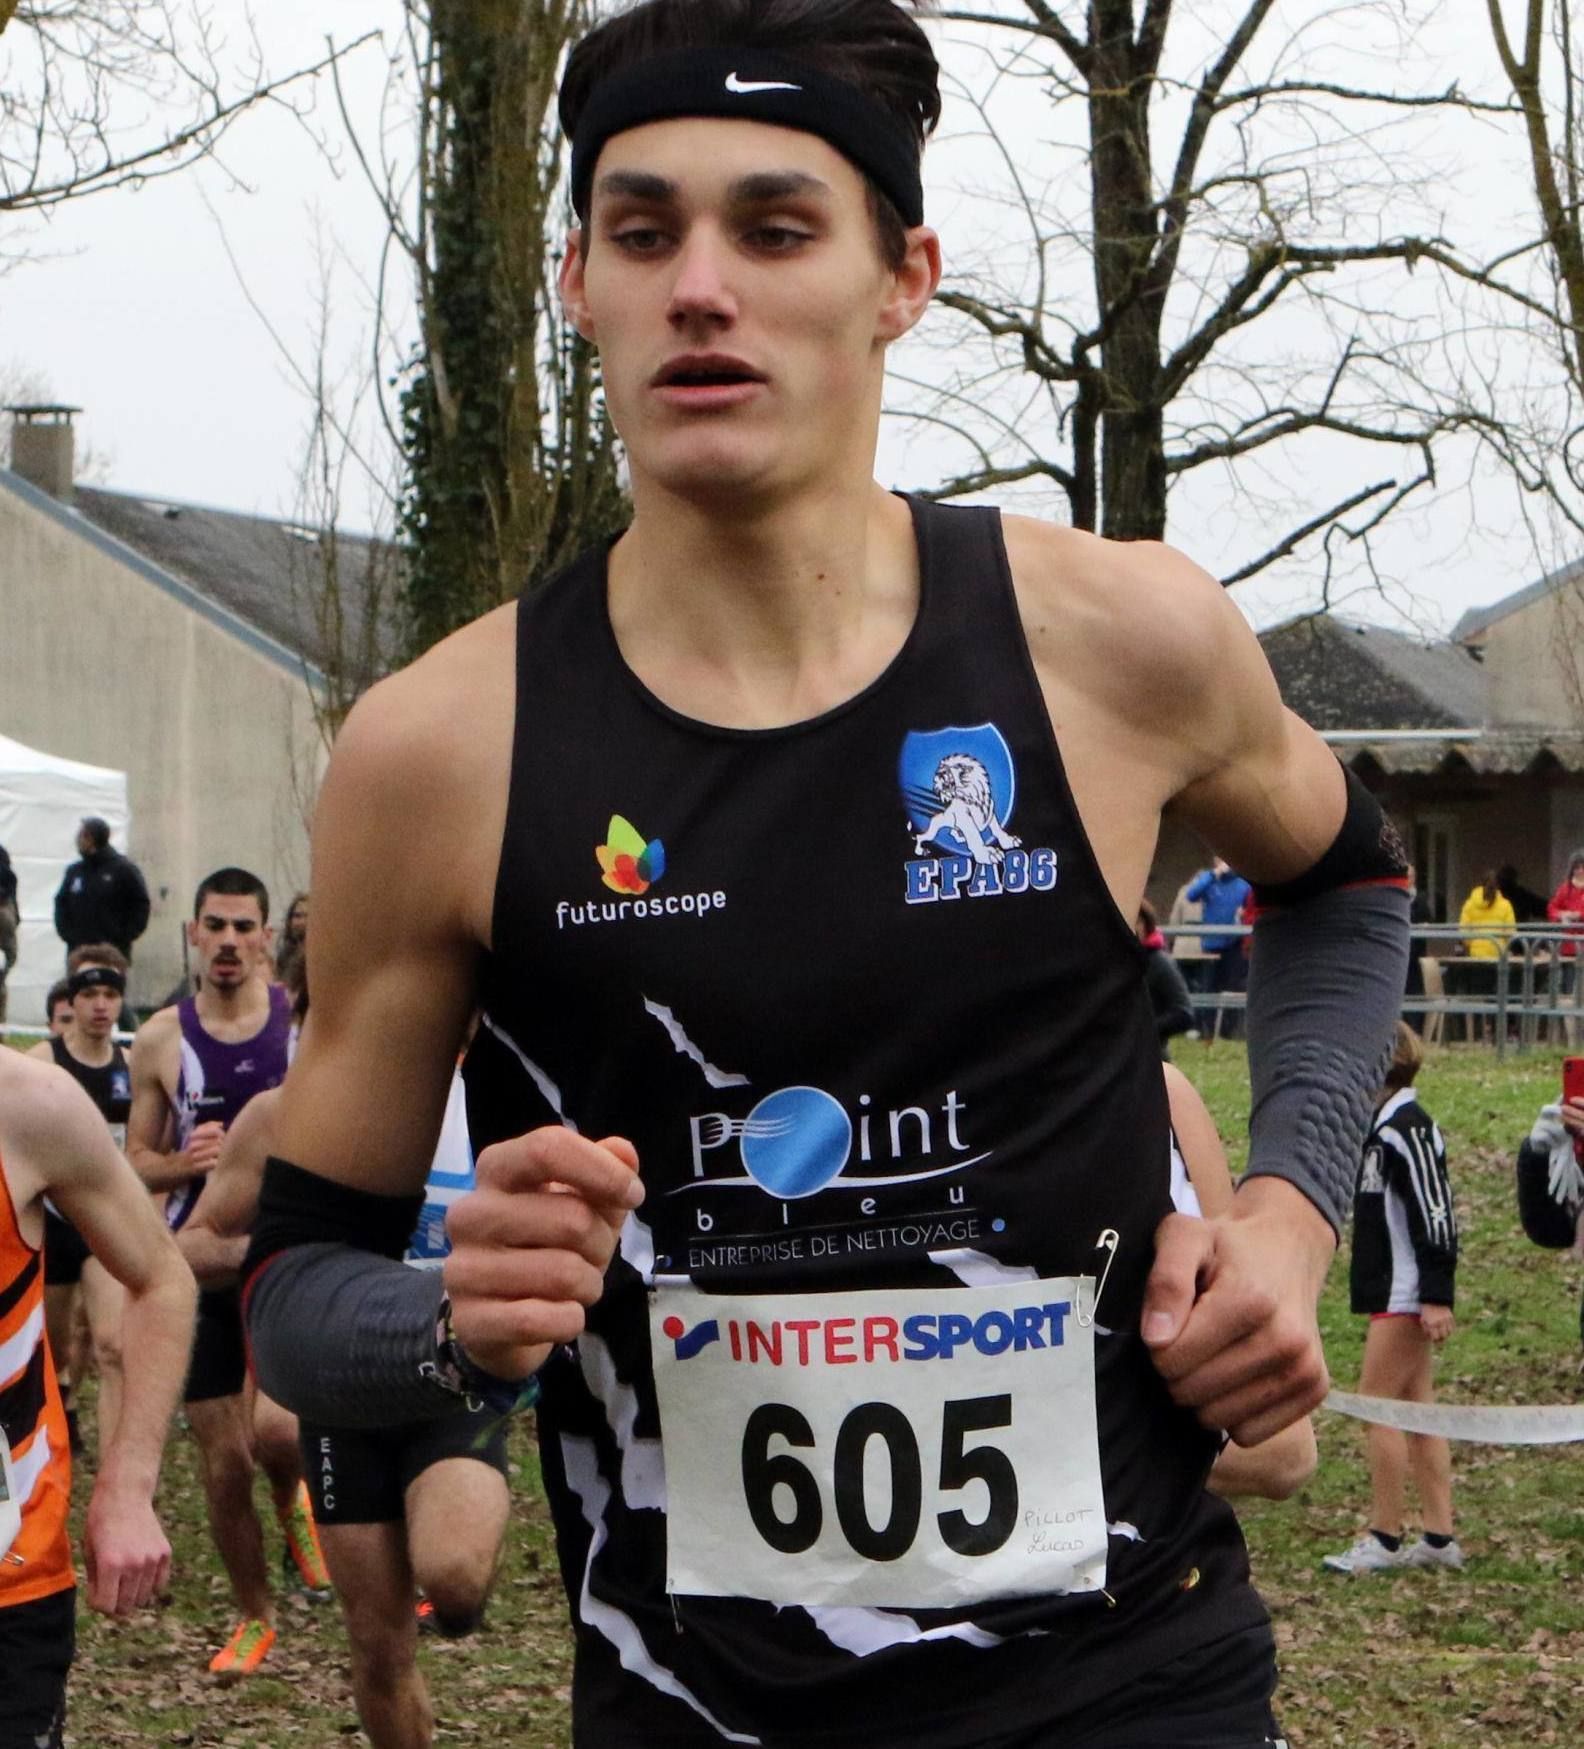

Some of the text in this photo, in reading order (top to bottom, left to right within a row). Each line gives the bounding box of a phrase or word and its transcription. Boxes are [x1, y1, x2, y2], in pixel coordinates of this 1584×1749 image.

[905, 848, 1057, 904] EPA86
[556, 890, 727, 929] futuroscope
[689, 1219, 980, 1268] ENTREPRISE DE NETTOYAGE
[728, 1301, 1071, 1366] INTERSPORT
[320, 1437, 336, 1510] EAPC
[741, 1393, 1019, 1562] 605
